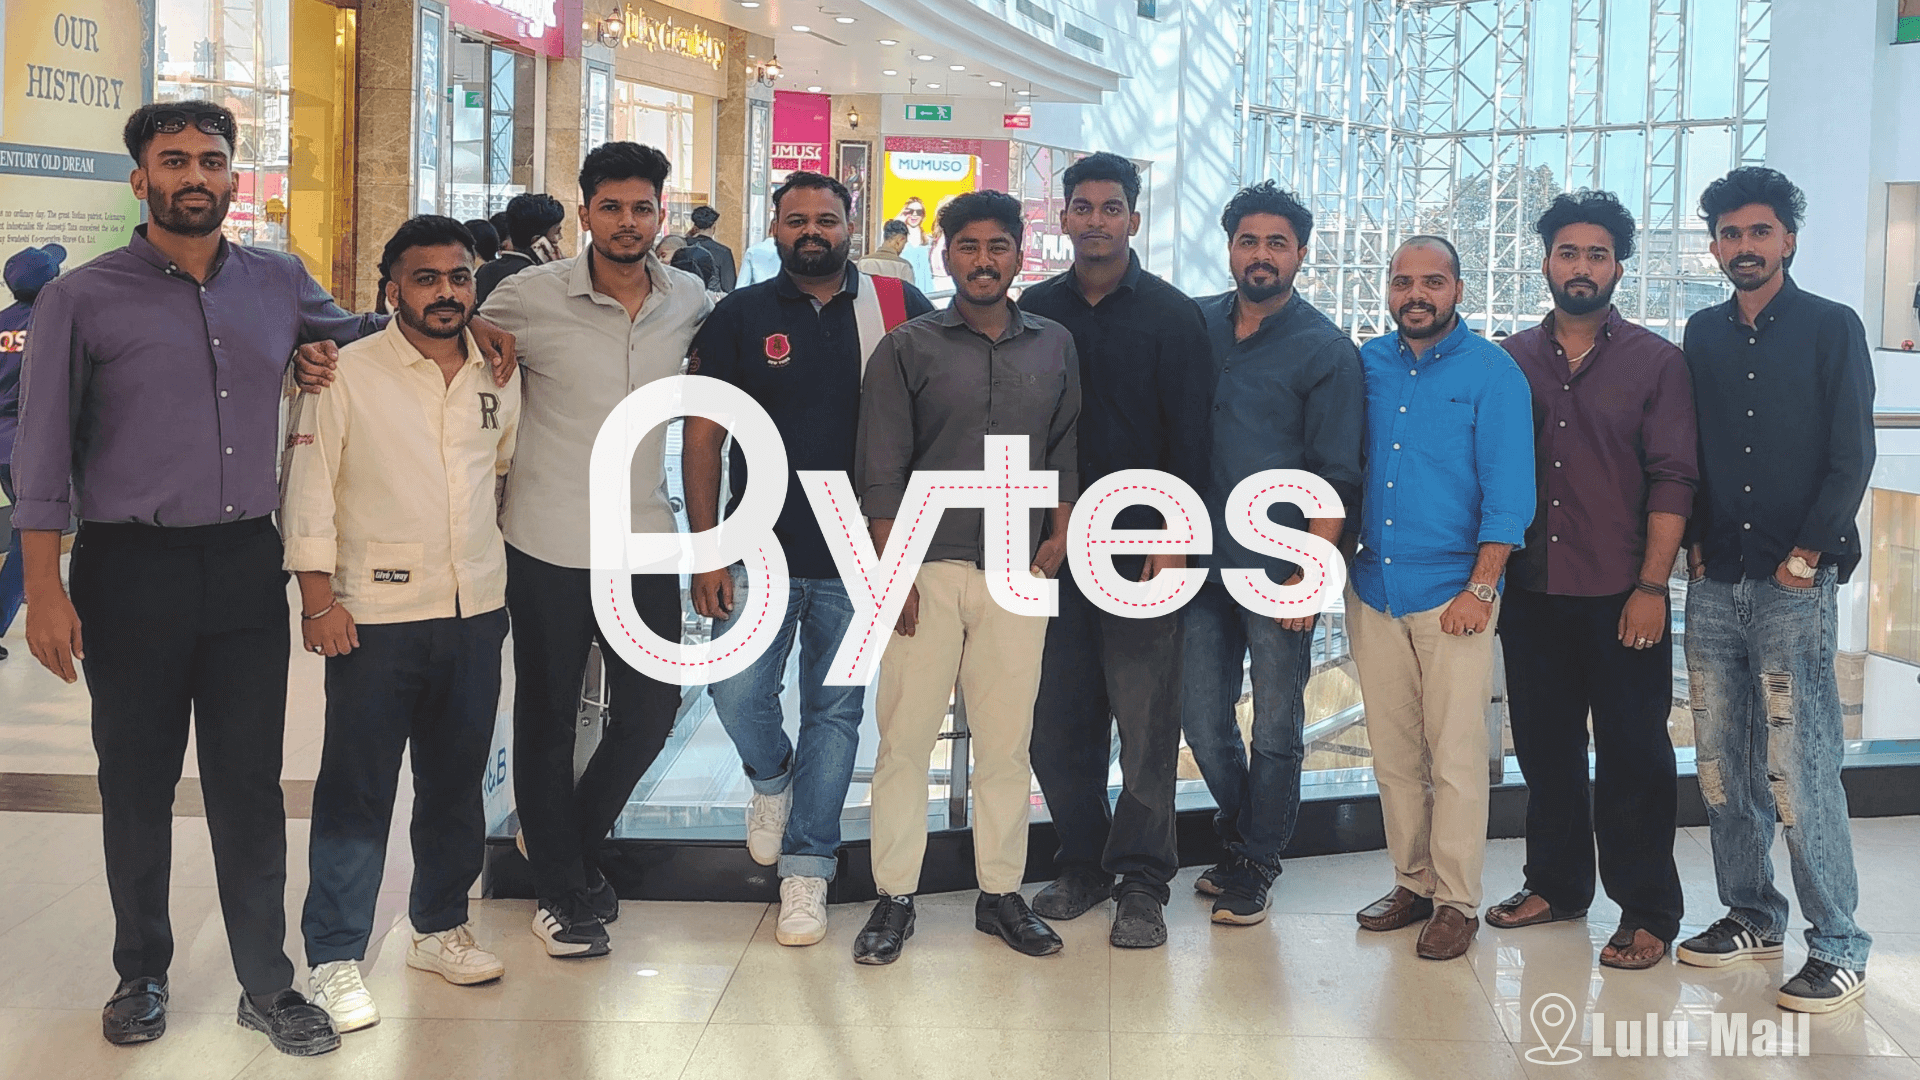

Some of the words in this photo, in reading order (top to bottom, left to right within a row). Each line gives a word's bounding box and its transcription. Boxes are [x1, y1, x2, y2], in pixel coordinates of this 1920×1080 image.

[54, 13, 99, 53] OUR
[26, 63, 124, 110] HISTORY
[0, 150, 41, 169] ENTURY
[41, 153, 61, 170] OLD
[62, 155, 95, 173] DREAM
[898, 158, 962, 172] MUMUSO
[477, 391, 501, 430] R
